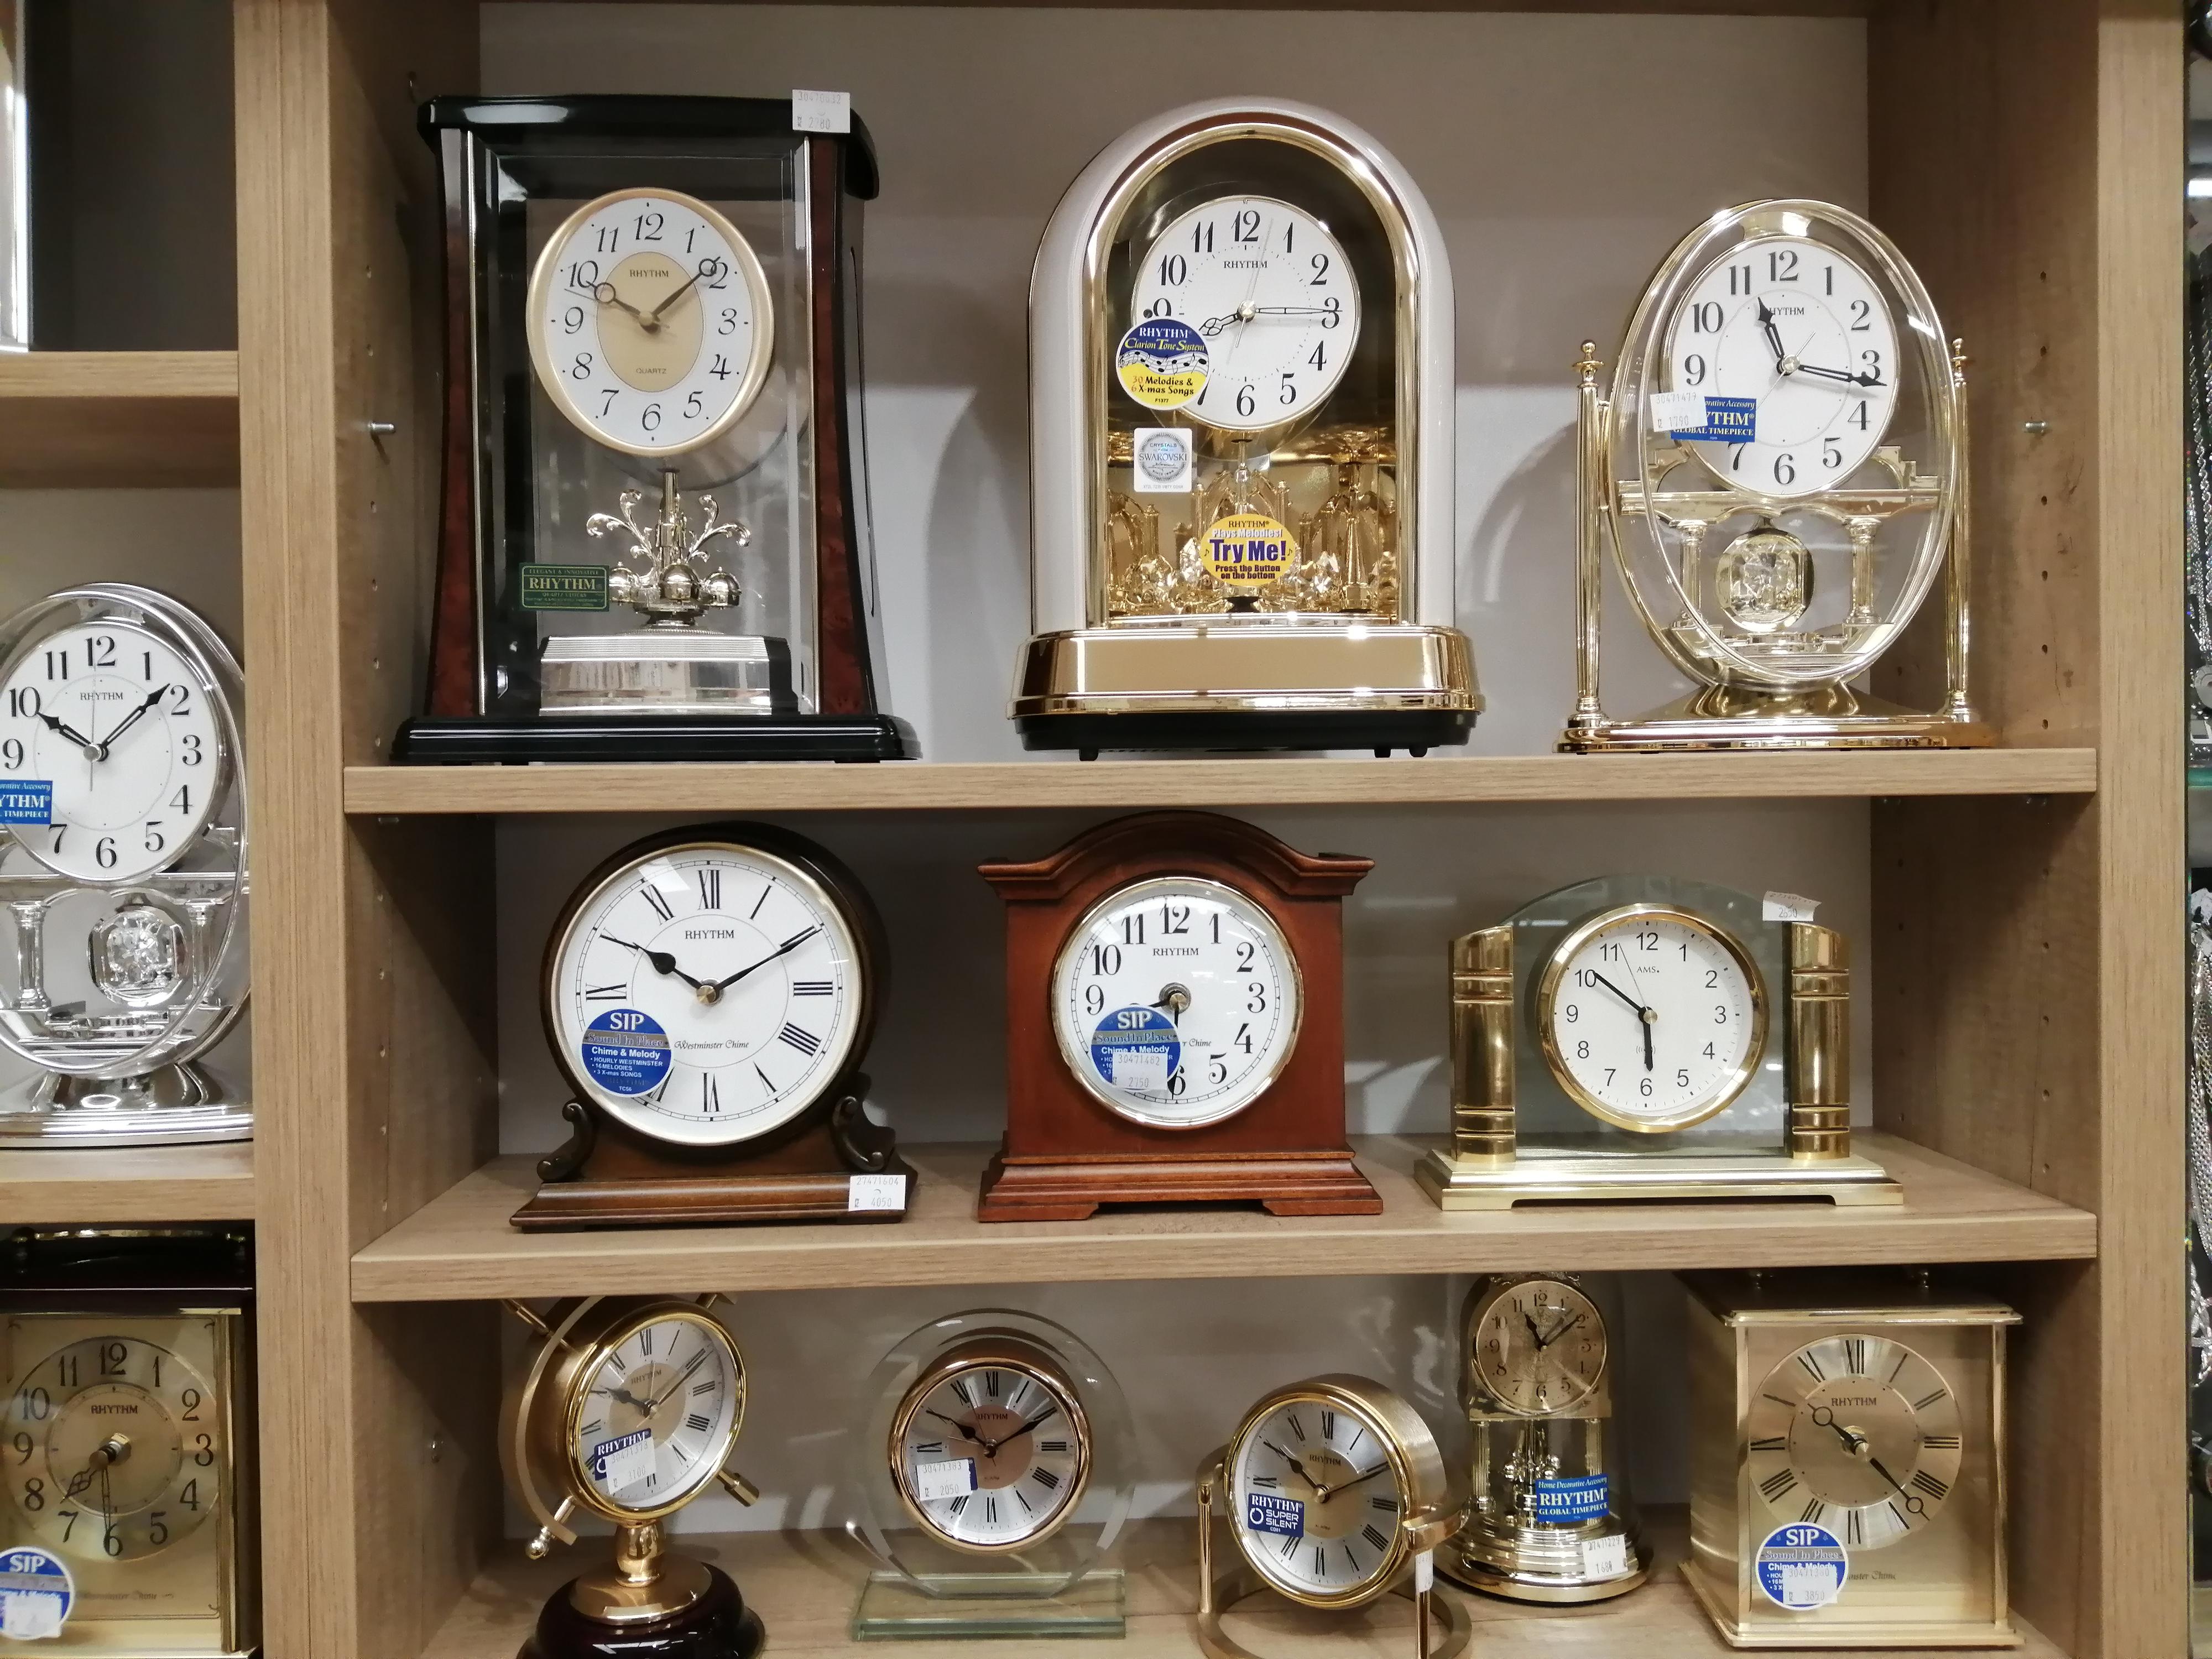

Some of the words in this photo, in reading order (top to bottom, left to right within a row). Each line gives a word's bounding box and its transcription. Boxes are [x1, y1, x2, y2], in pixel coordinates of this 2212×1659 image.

[635, 213, 664, 241] 12
[1231, 210, 1260, 242] 12
[597, 227, 619, 253] 11
[629, 269, 669, 278] RHYTHM
[1157, 254, 1187, 286] 10
[1224, 260, 1268, 269] RHYTHM
[1310, 253, 1328, 285] 2
[1768, 250, 1799, 281] 12
[565, 306, 584, 335] 9
[1692, 301, 1724, 333] 10
[1767, 307, 1804, 316] HYTHM
[718, 308, 737, 335] 3
[1139, 327, 1188, 338] RHYTHM
[1124, 337, 1156, 349] Clarion
[1156, 338, 1176, 350] Tone
[1176, 340, 1204, 352] System
[572, 352, 592, 379] 8
[1684, 354, 1705, 386] 9
[1145, 376, 1183, 385] Melodies
[1280, 373, 1296, 404] 5
[1139, 385, 1165, 393] X-mas
[1168, 387, 1194, 397] Songs
[1237, 384, 1255, 416] 6
[601, 389, 619, 416] 7
[684, 391, 703, 419] 5
[1726, 400, 1755, 411] Accessory
[641, 404, 661, 431] 6
[1709, 427, 1754, 436] TIMEPIECE
[1773, 453, 1795, 484] 6
[1213, 529, 1237, 538] Plays
[1209, 539, 1244, 564] Try
[1248, 540, 1286, 561] Me!
[530, 577, 596, 590] RHYTHM
[85, 635, 116, 667] 12
[44, 650, 67, 680] 11
[80, 692, 123, 700] RHYTHM
[170, 685, 190, 716] 2
[182, 735, 201, 765] 3
[169, 784, 193, 815] 4
[95, 837, 117, 868] 6
[1160, 904, 1190, 934] 12
[684, 930, 735, 940] RHYTHM
[1636, 932, 1658, 951] 12
[1091, 944, 1121, 976] 10
[1152, 947, 1199, 956] RHYTHM
[1237, 942, 1254, 973] 2
[1678, 944, 1687, 962] 1
[1705, 970, 1718, 989] 2
[1247, 982, 1266, 1014] 3
[610, 1012, 645, 1031] SIP
[1117, 1011, 1152, 1030] SIP
[1714, 1005, 1726, 1024] 3
[588, 1032, 620, 1045] Sound
[636, 1035, 664, 1047] Place
[674, 1040, 724, 1050] Westminster
[726, 1040, 749, 1048] Chime
[1097, 1032, 1130, 1044] Sound
[1144, 1032, 1172, 1041] Place
[1190, 1038, 1212, 1046] Chime
[592, 1046, 618, 1056] Chime
[629, 1050, 660, 1059] Melody
[1139, 1045, 1170, 1053] Melody
[1577, 1040, 1590, 1059] 8
[1129, 1077, 1149, 1088] 2750
[1604, 1068, 1616, 1087] 7
[1676, 1069, 1689, 1088] 5
[98, 1343, 128, 1375] 12
[91, 1405, 138, 1415] RHYTHM
[181, 1389, 201, 1421] 2
[1831, 1397, 1877, 1407] RHYTHM
[194, 1433, 213, 1467] 3
[598, 1431, 645, 1455] RHYTHM
[1309, 1454, 1342, 1467] RHYTHM
[24, 1477, 44, 1511] 8
[940, 1484, 959, 1495] 2050
[1540, 1488, 1604, 1506] RHYTHM
[1266, 1509, 1298, 1522] SUPER
[1572, 1501, 1608, 1514] TIMEPIECE
[1266, 1517, 1298, 1530] SILENT
[1786, 1528, 1820, 1546] SIP
[9, 1554, 45, 1573] SIP
[1765, 1550, 1797, 1559] Sound
[1812, 1550, 1839, 1559] Place
